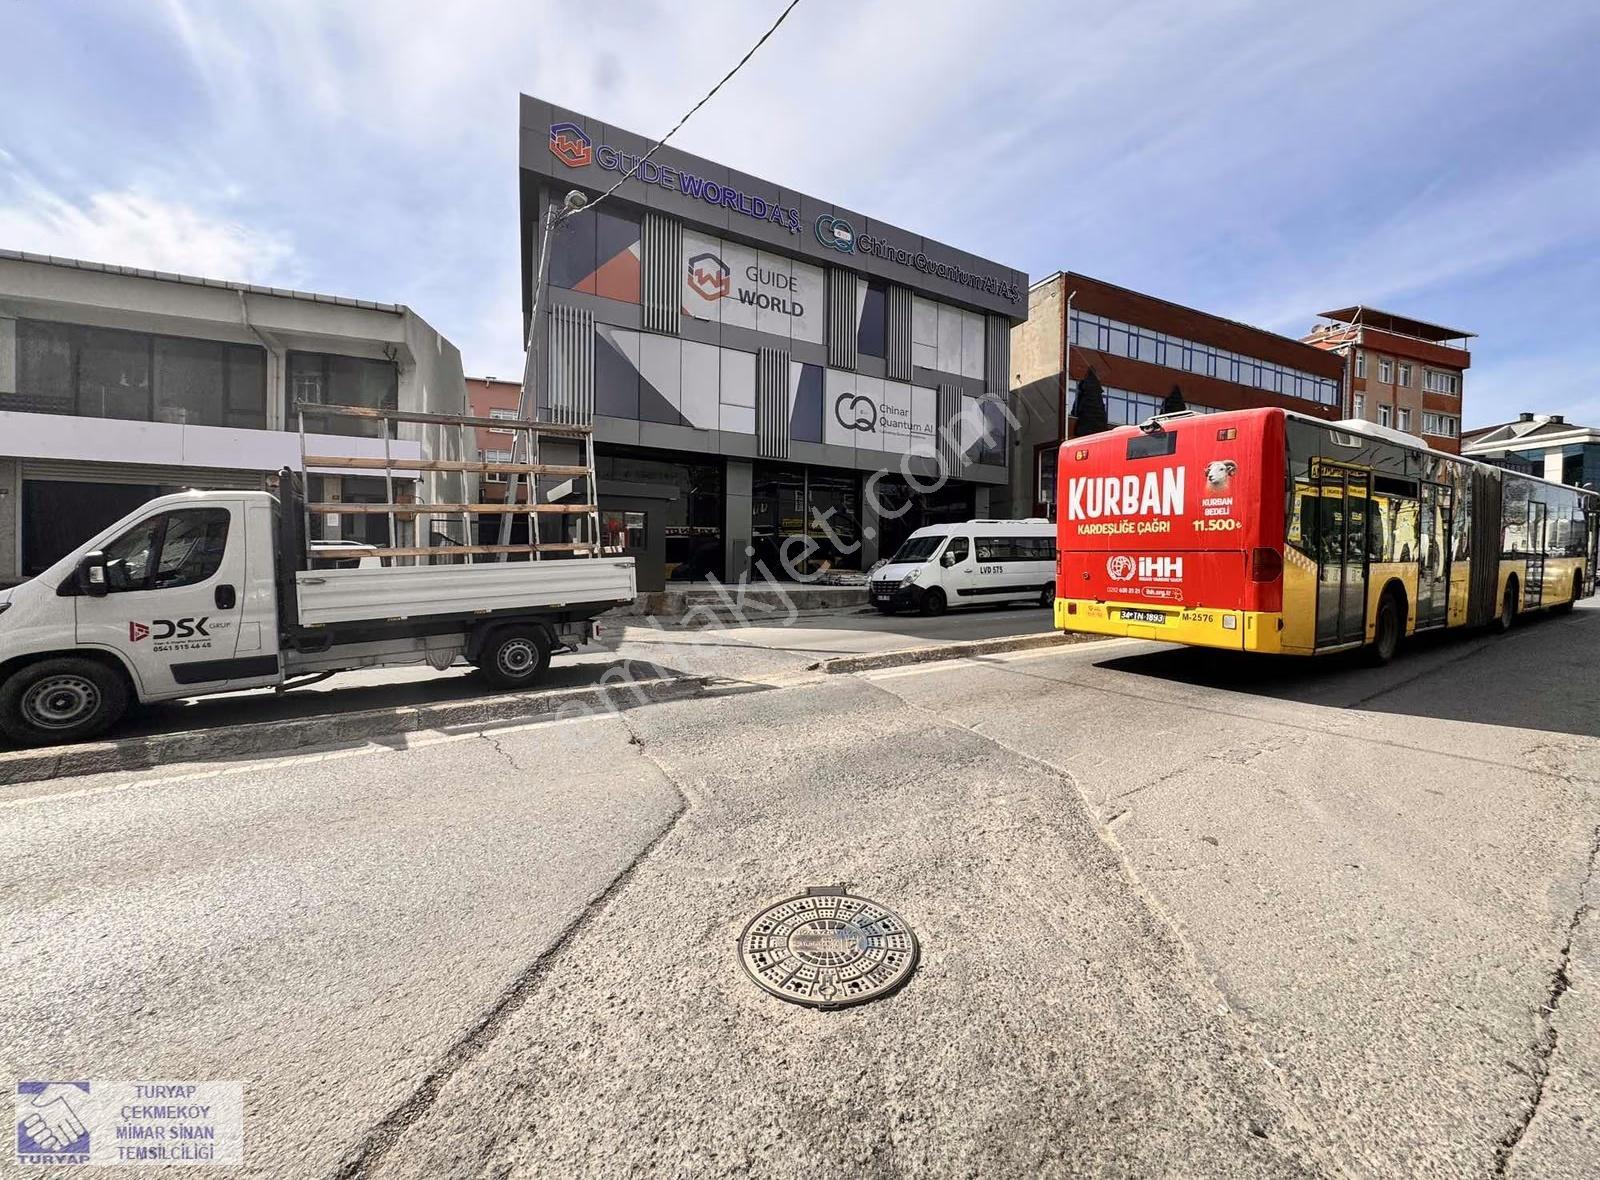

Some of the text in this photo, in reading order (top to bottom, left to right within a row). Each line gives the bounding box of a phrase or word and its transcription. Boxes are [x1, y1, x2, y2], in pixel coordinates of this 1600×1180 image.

[595, 144, 676, 190] GUIDE
[678, 170, 768, 219] WORLD
[857, 233, 913, 267] Chinar
[914, 252, 981, 290] Quantum
[745, 265, 798, 293] GUIDE
[738, 287, 804, 317] WORLD
[879, 403, 909, 417] Chinar
[879, 416, 922, 431] Quantum
[1068, 466, 1185, 521] KURBAN
[1202, 497, 1233, 506] KURBAN
[1077, 518, 1170, 536] KARDEŞLİĞE ÇAĞRI
[980, 566, 992, 574] LVD
[153, 616, 210, 639] DSK
[1182, 613, 1214, 623] M-2576
